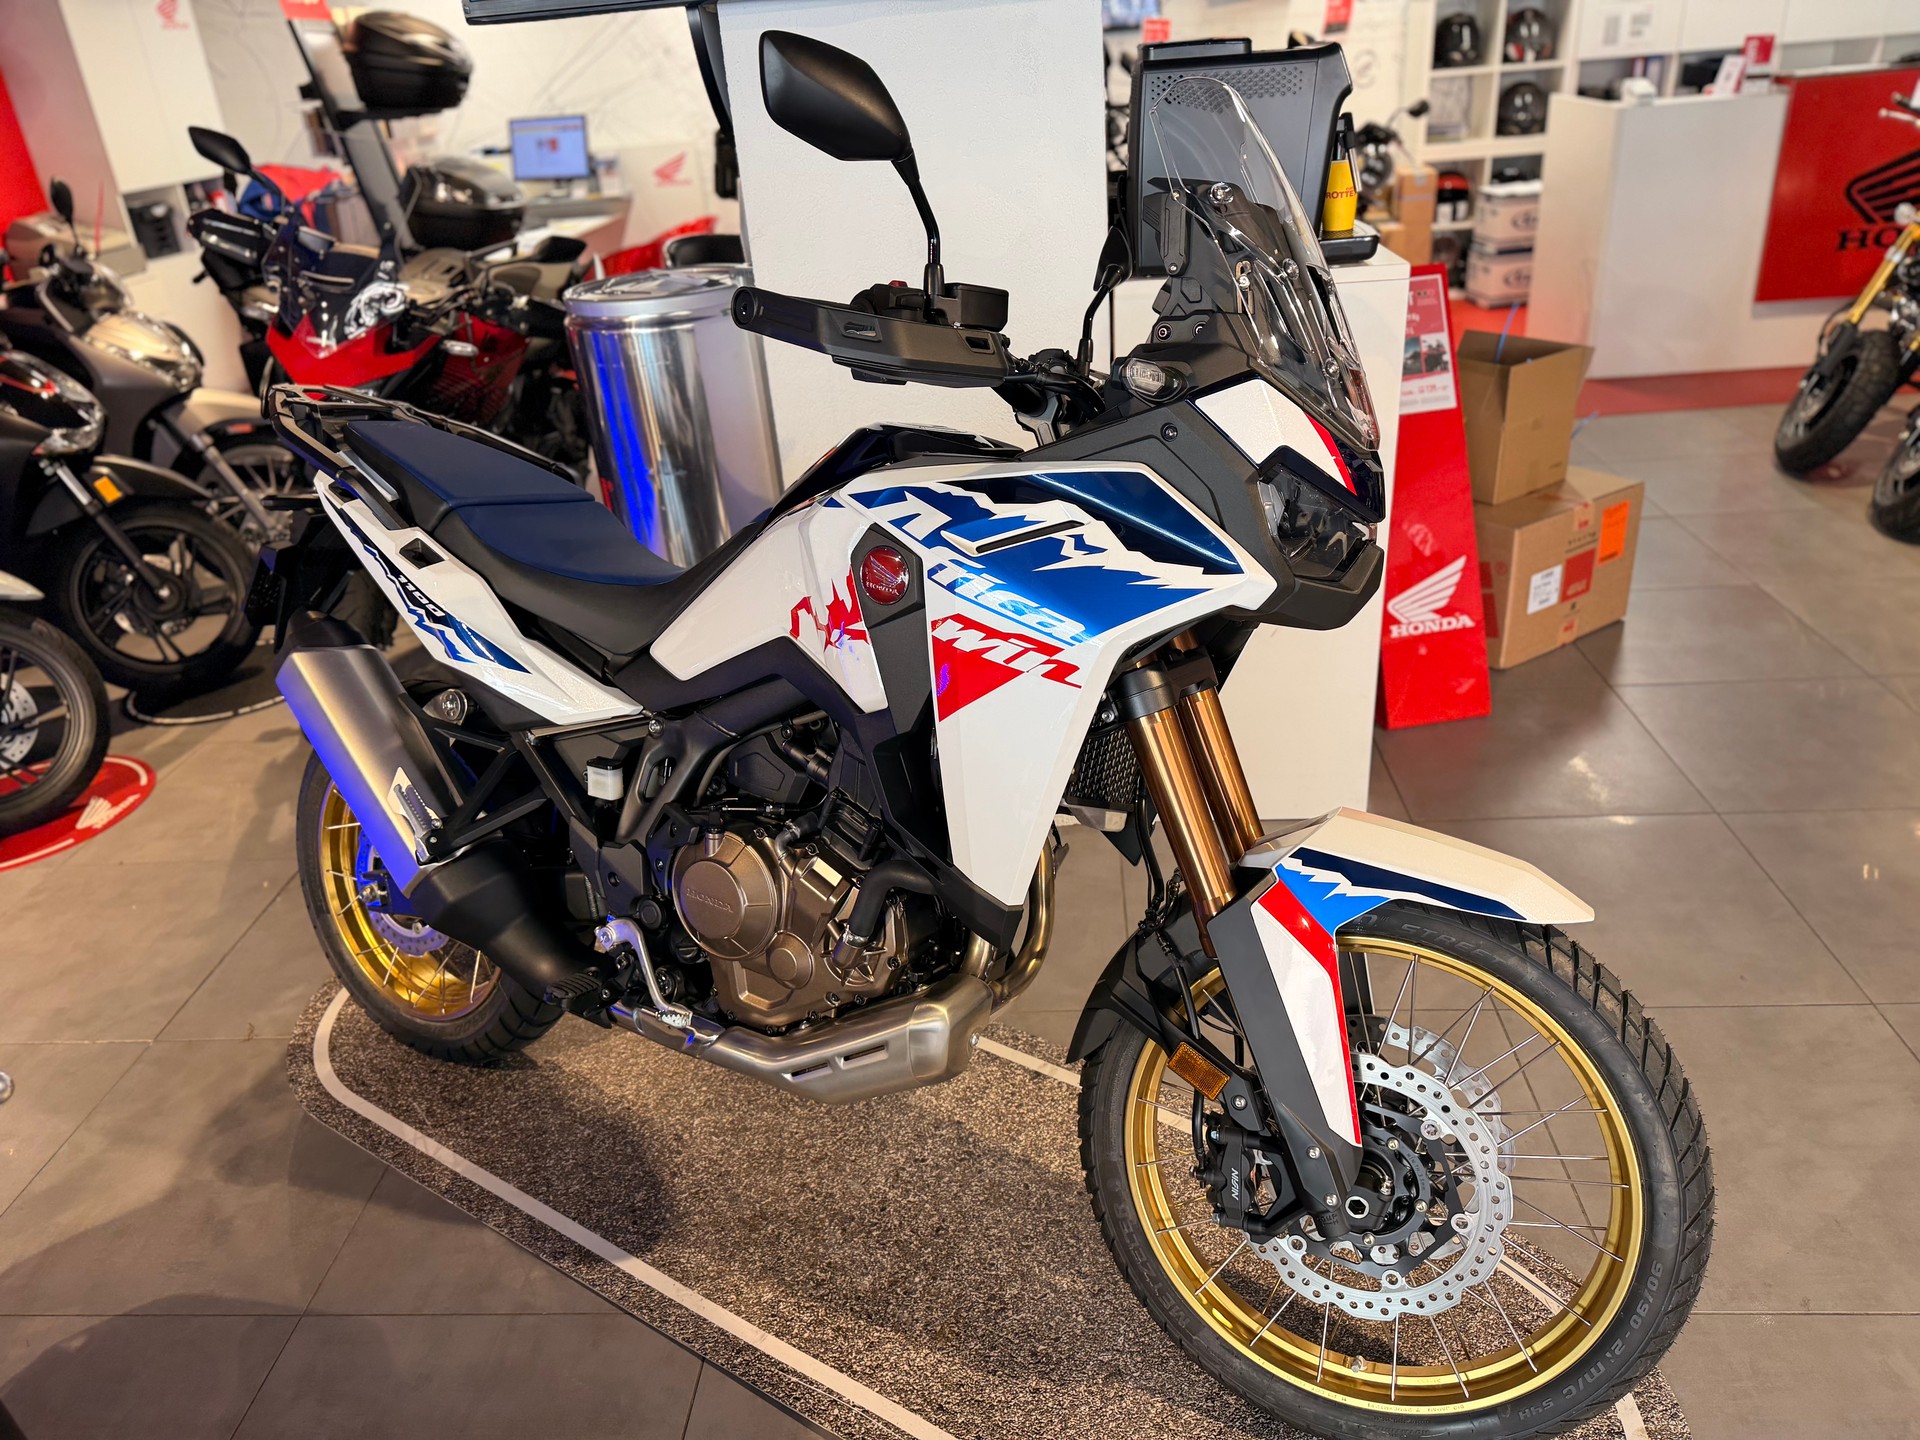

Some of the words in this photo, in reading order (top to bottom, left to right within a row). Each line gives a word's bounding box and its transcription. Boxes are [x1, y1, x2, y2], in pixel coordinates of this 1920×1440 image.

[398, 574, 446, 617] 1100
[1389, 613, 1476, 639] HONDA
[686, 888, 734, 913] HONDA
[1231, 1167, 1239, 1201] NISSIN
[1113, 1203, 1191, 1328] METZELER
[1630, 1260, 1663, 1330] 90/90
[1518, 1398, 1554, 1420] 54H
